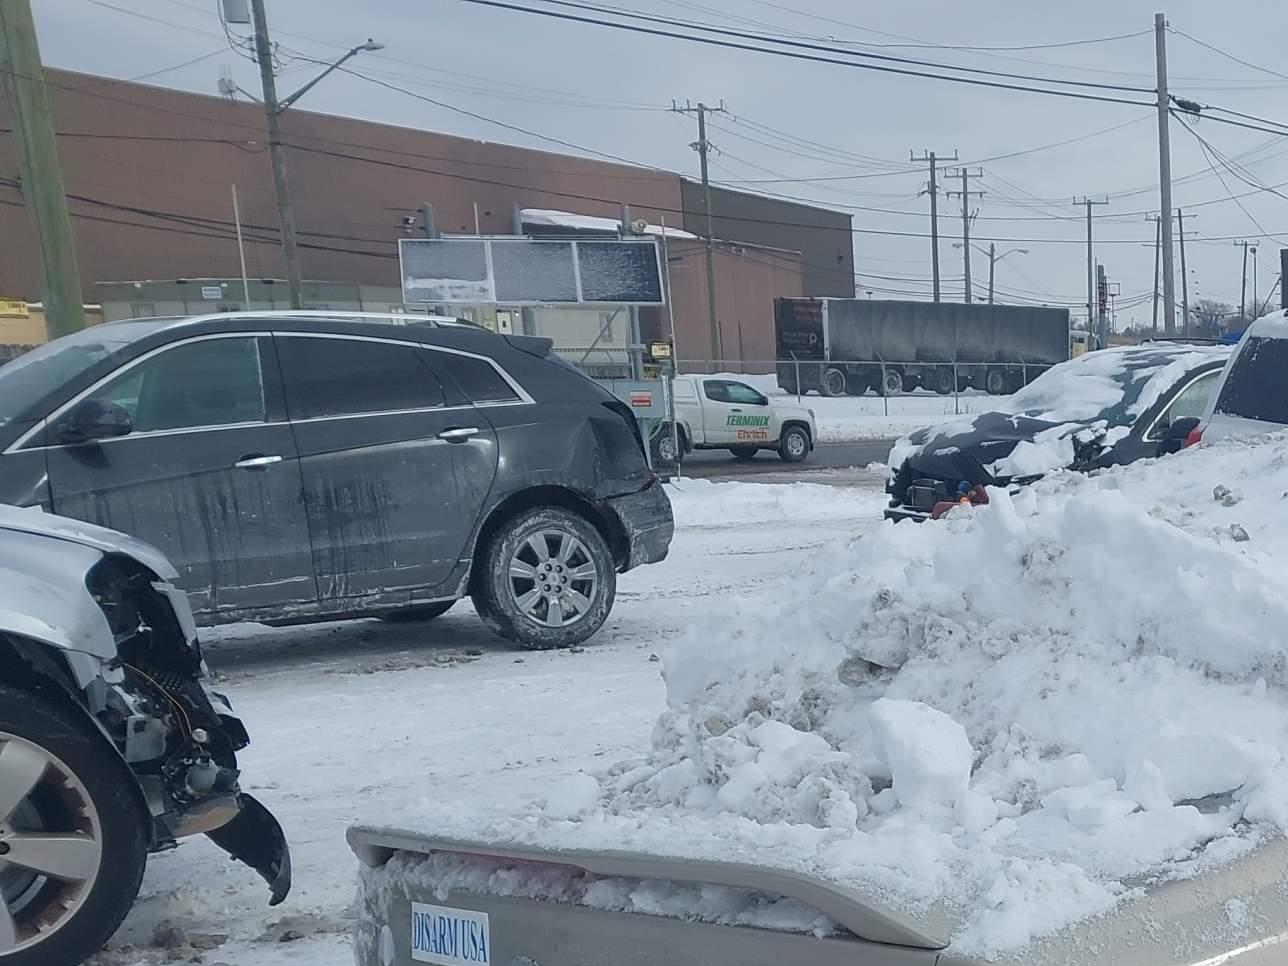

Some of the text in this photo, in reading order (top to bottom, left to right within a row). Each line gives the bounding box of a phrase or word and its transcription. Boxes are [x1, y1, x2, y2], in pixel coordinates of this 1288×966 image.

[726, 415, 770, 427] TERMINIX
[413, 911, 489, 963] DISARM USA
